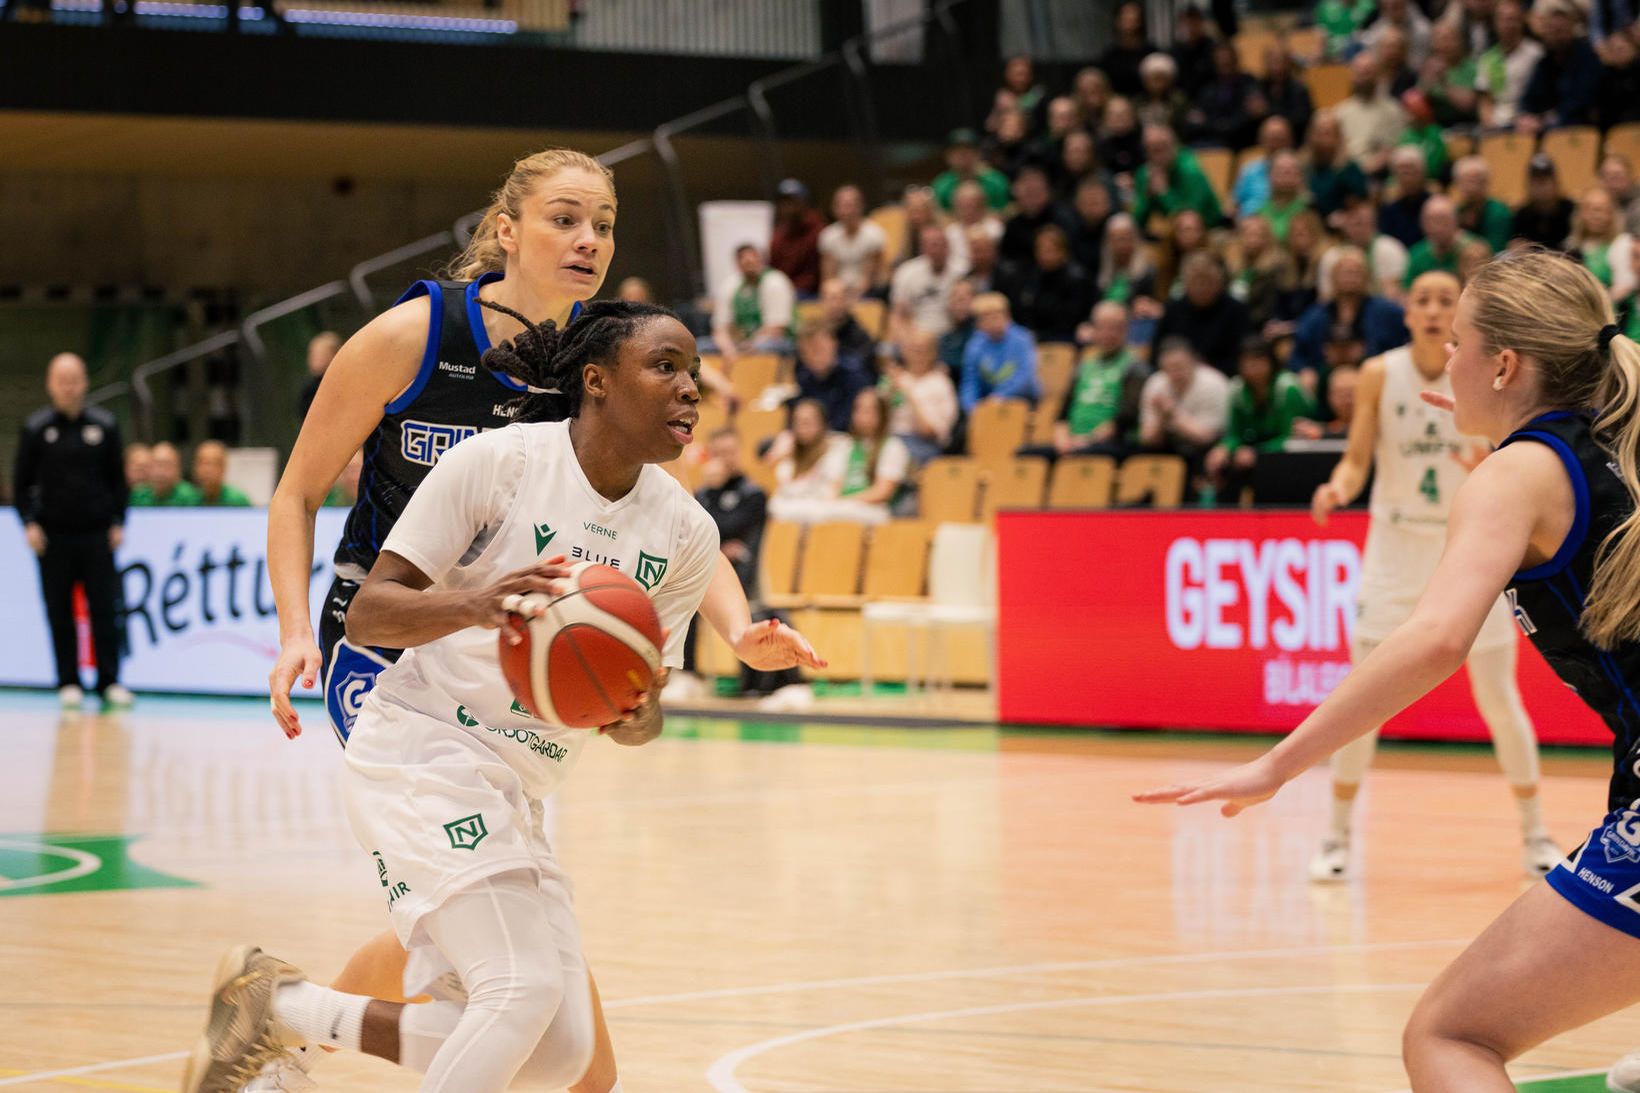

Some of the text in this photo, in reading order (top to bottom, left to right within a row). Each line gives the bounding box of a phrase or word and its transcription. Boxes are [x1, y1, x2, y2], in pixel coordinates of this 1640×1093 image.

[438, 360, 476, 375] Mustad
[1419, 466, 1440, 504] 4
[583, 521, 618, 541] VERNE
[571, 546, 621, 570] BLUE
[1166, 537, 1364, 651] GEYSIR
[1577, 867, 1615, 894] HENSON
